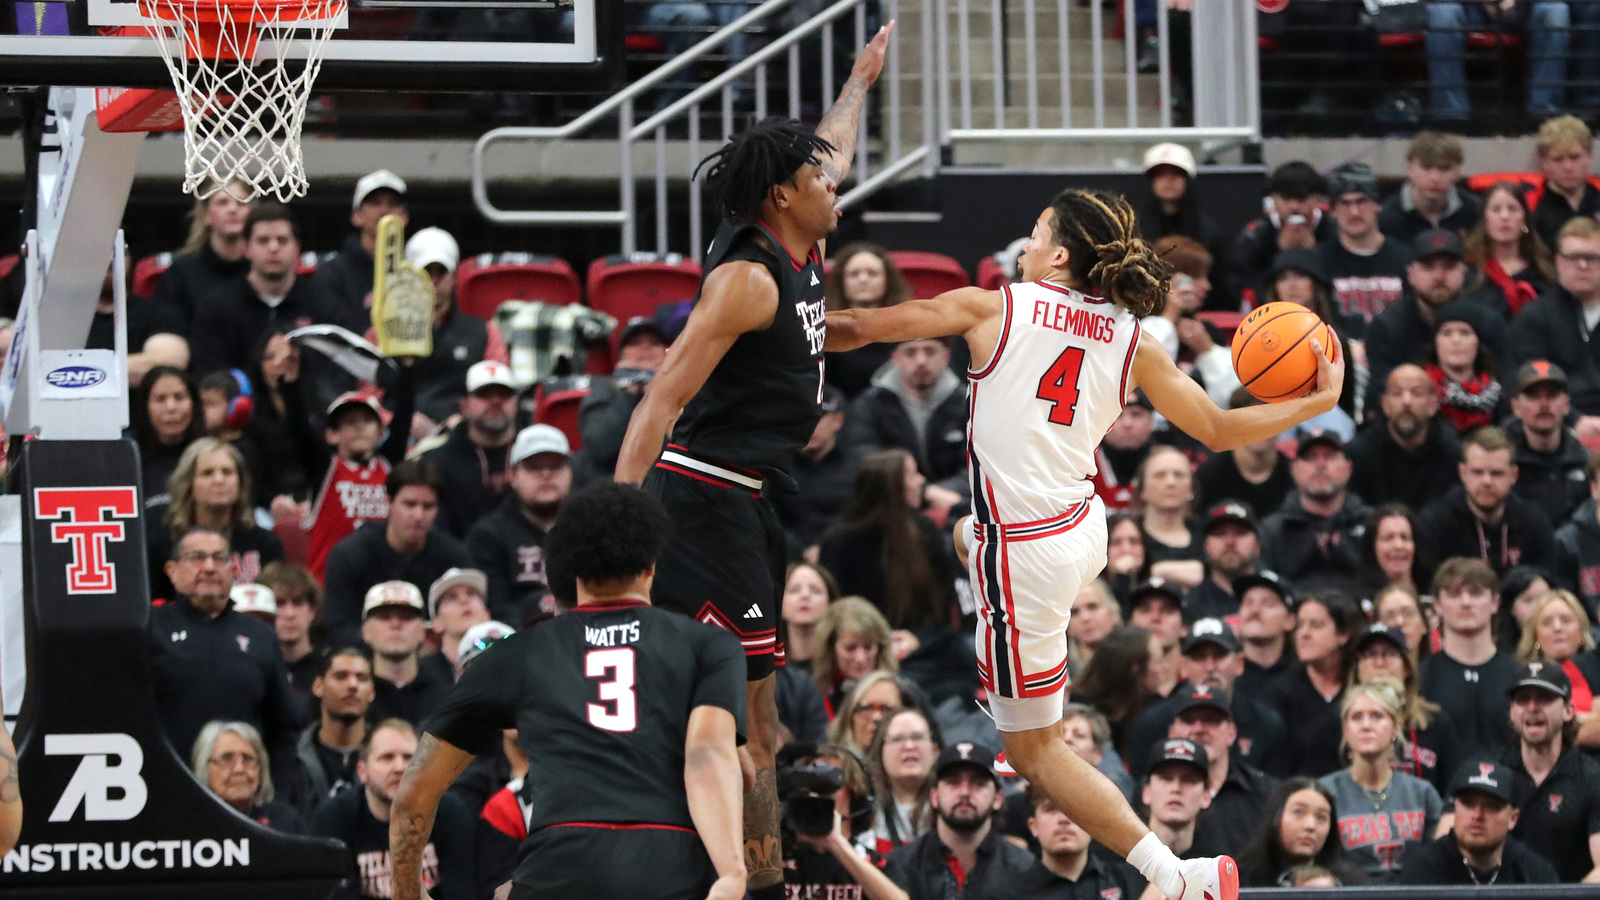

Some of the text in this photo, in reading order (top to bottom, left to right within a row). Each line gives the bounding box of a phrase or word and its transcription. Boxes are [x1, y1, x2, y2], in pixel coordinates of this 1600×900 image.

[1032, 300, 1115, 343] FLEMINGS
[1036, 346, 1085, 426] 4
[585, 620, 640, 646] WATTS
[584, 646, 638, 733] 3
[0, 838, 250, 873] NSTRUCTION
